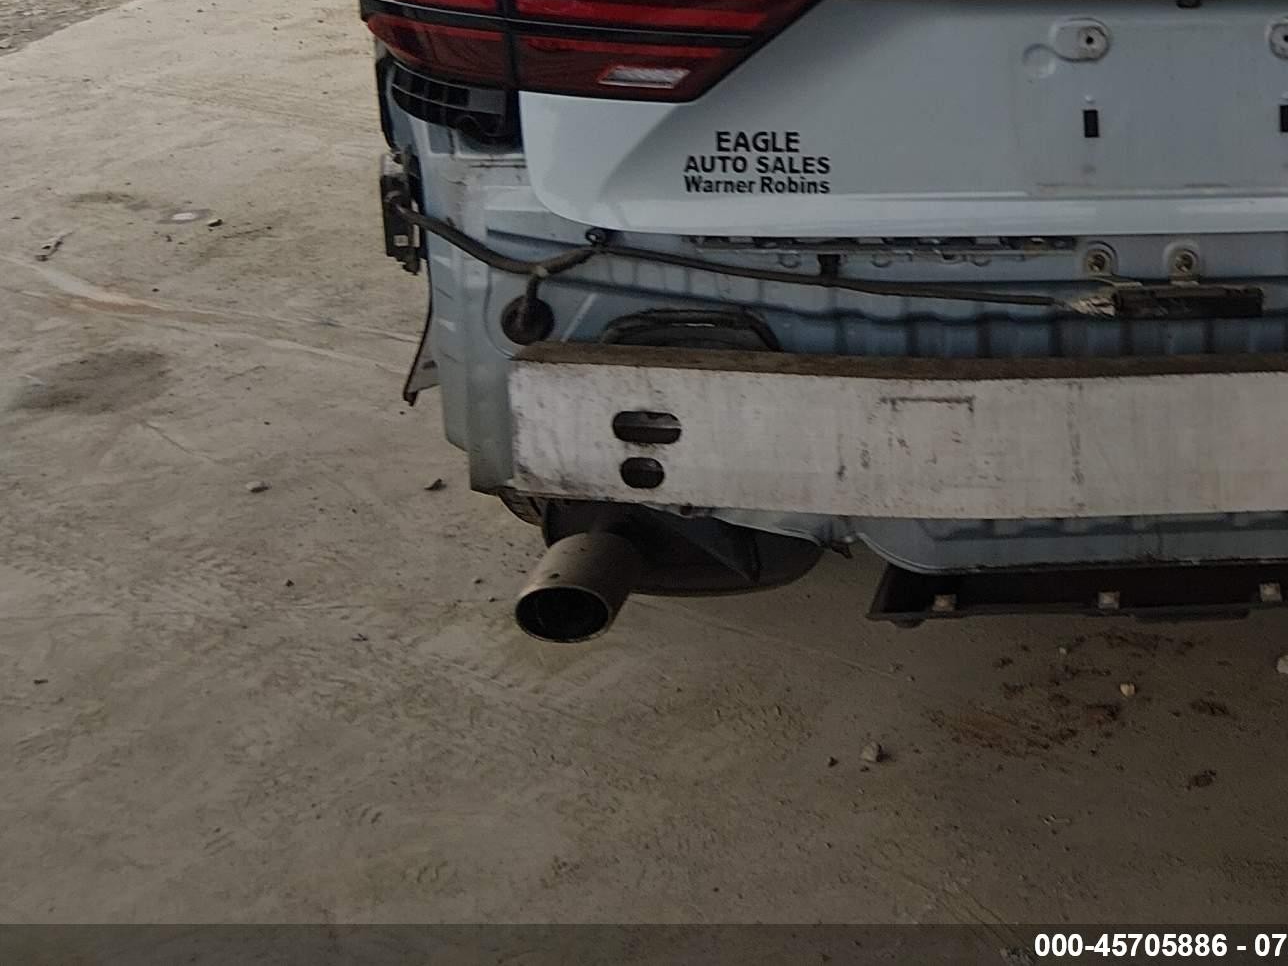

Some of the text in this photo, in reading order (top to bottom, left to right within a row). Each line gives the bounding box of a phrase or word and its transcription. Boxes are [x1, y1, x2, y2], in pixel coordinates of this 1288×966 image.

[715, 131, 800, 153] EAGLE
[684, 155, 831, 174] AUTO SALES
[683, 175, 831, 194] Warner Robins
